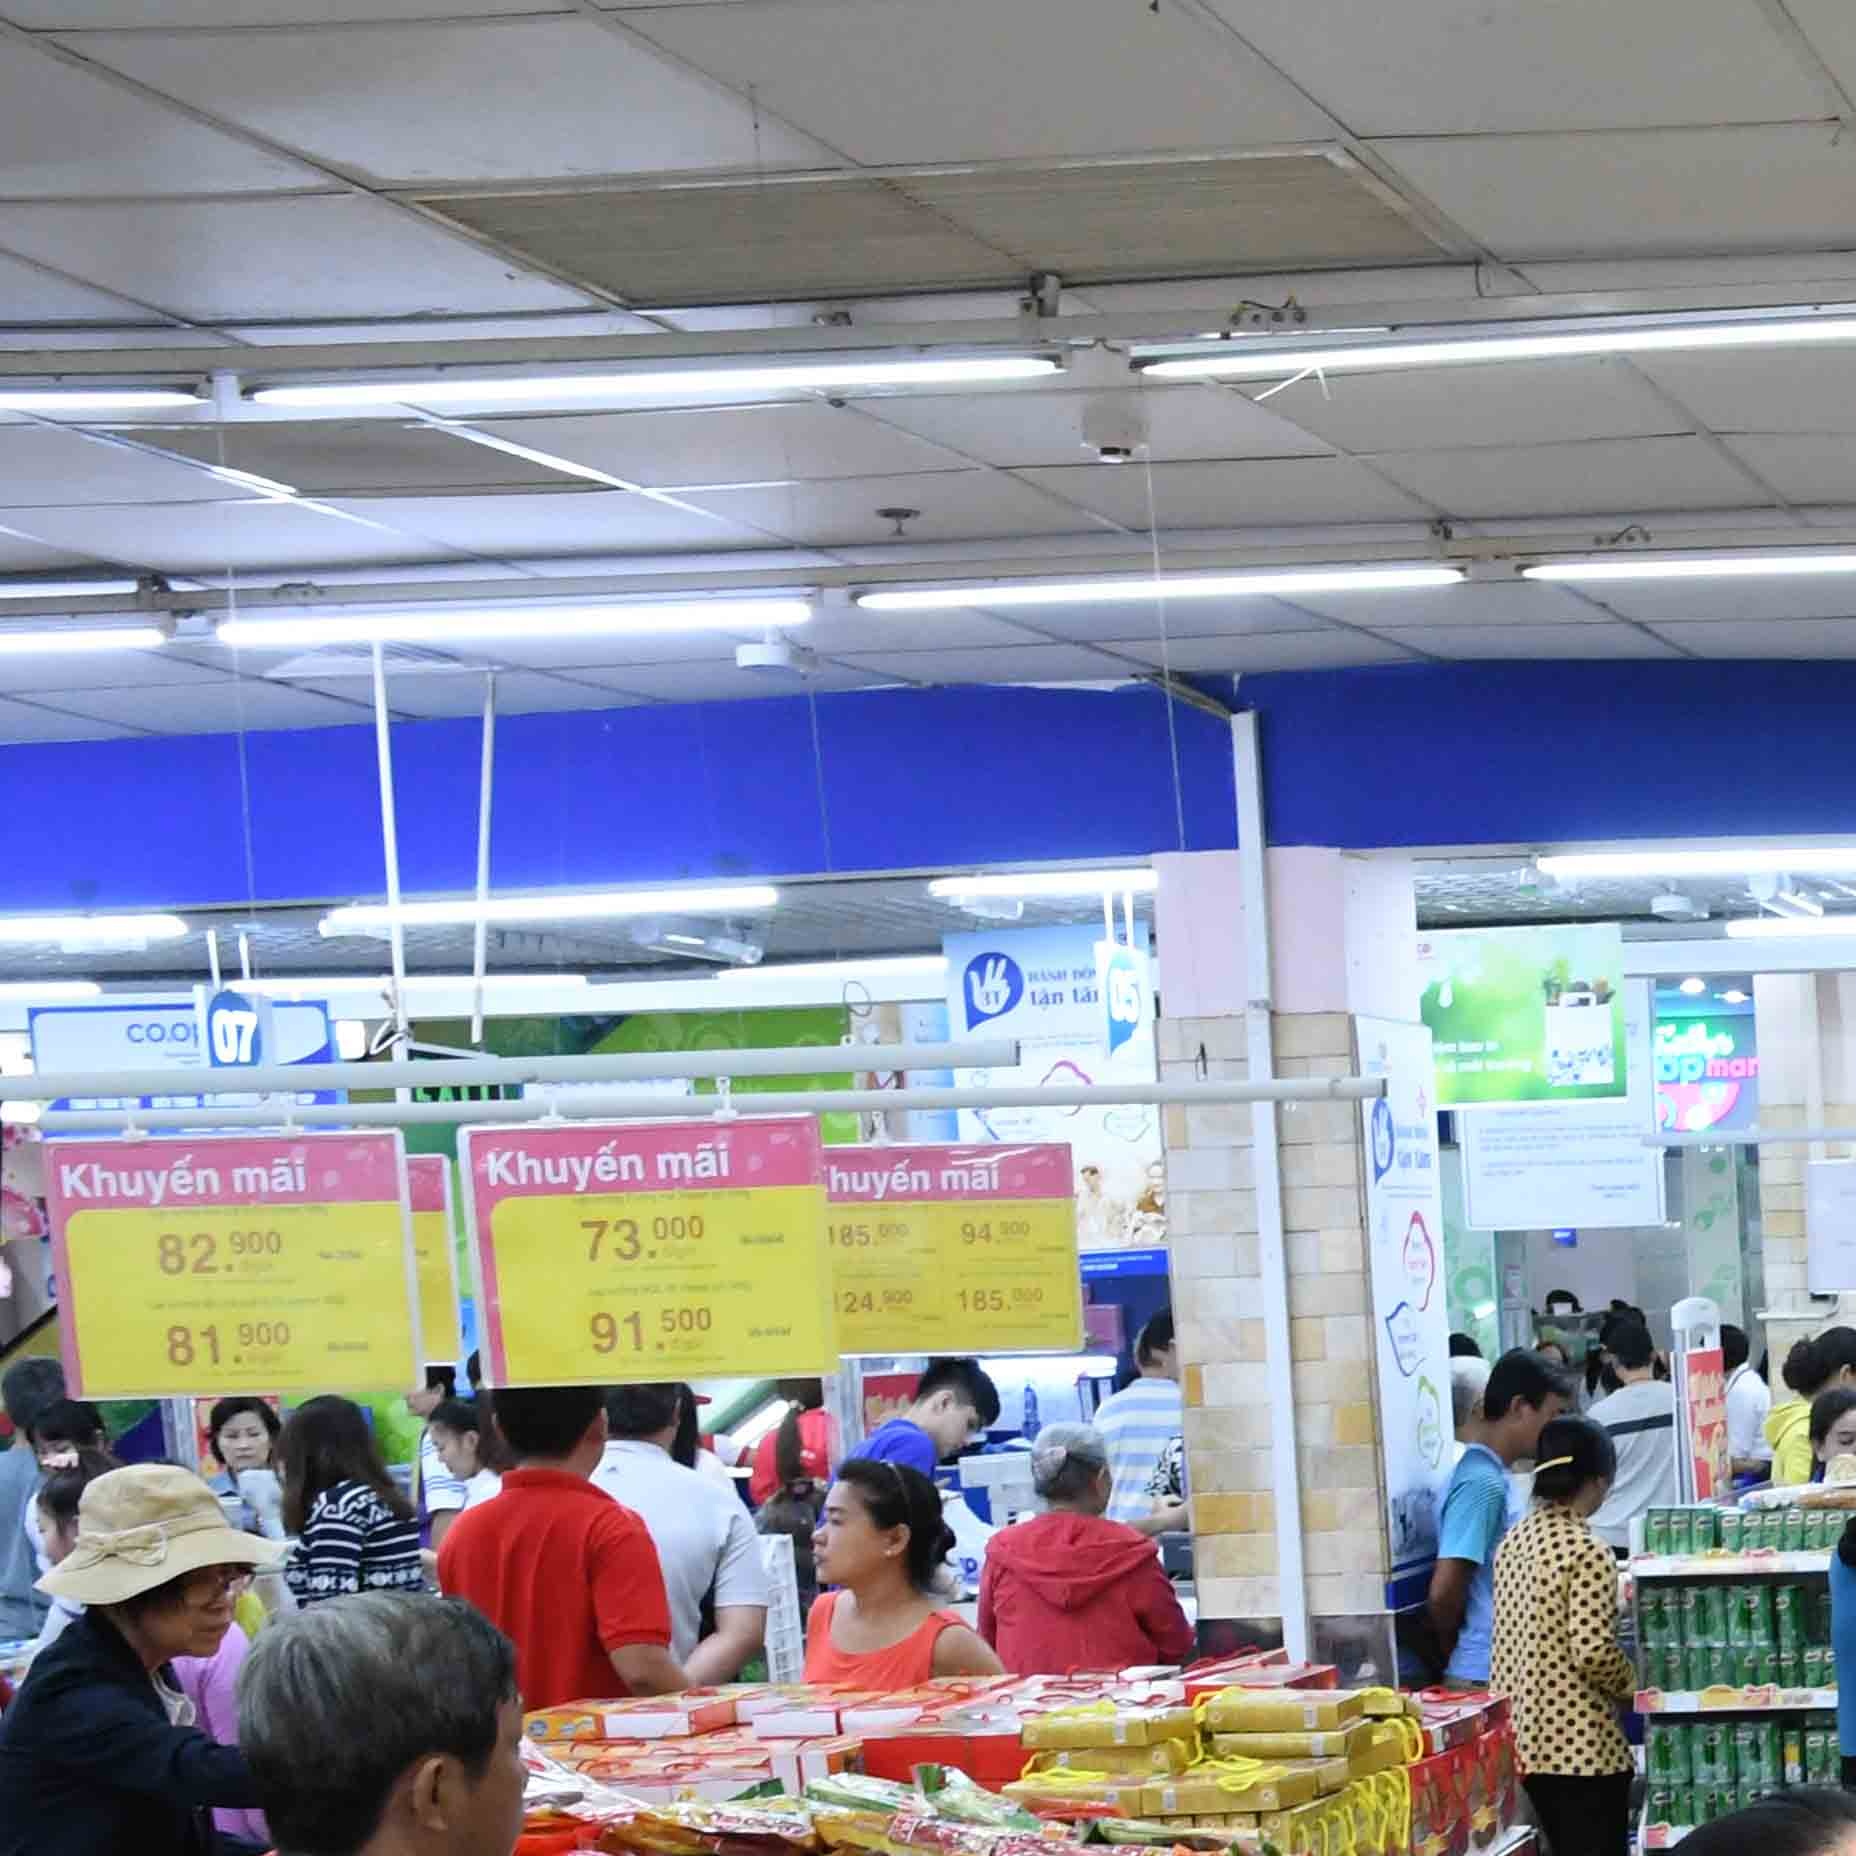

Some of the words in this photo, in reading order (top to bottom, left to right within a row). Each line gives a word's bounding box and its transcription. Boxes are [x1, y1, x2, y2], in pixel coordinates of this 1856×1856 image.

[211, 1008, 258, 1064] 07
[59, 1153, 221, 1205] Khuyến
[232, 1155, 306, 1195] mãi
[487, 1140, 643, 1192] Khuyến
[655, 1143, 730, 1180] mãi
[826, 1158, 932, 1200] huyến
[940, 1162, 1000, 1192] mãi
[157, 1230, 282, 1276] 82.900
[579, 1214, 705, 1262] 73.000
[165, 1321, 291, 1367] 81.900
[589, 1307, 713, 1354] 91.500
